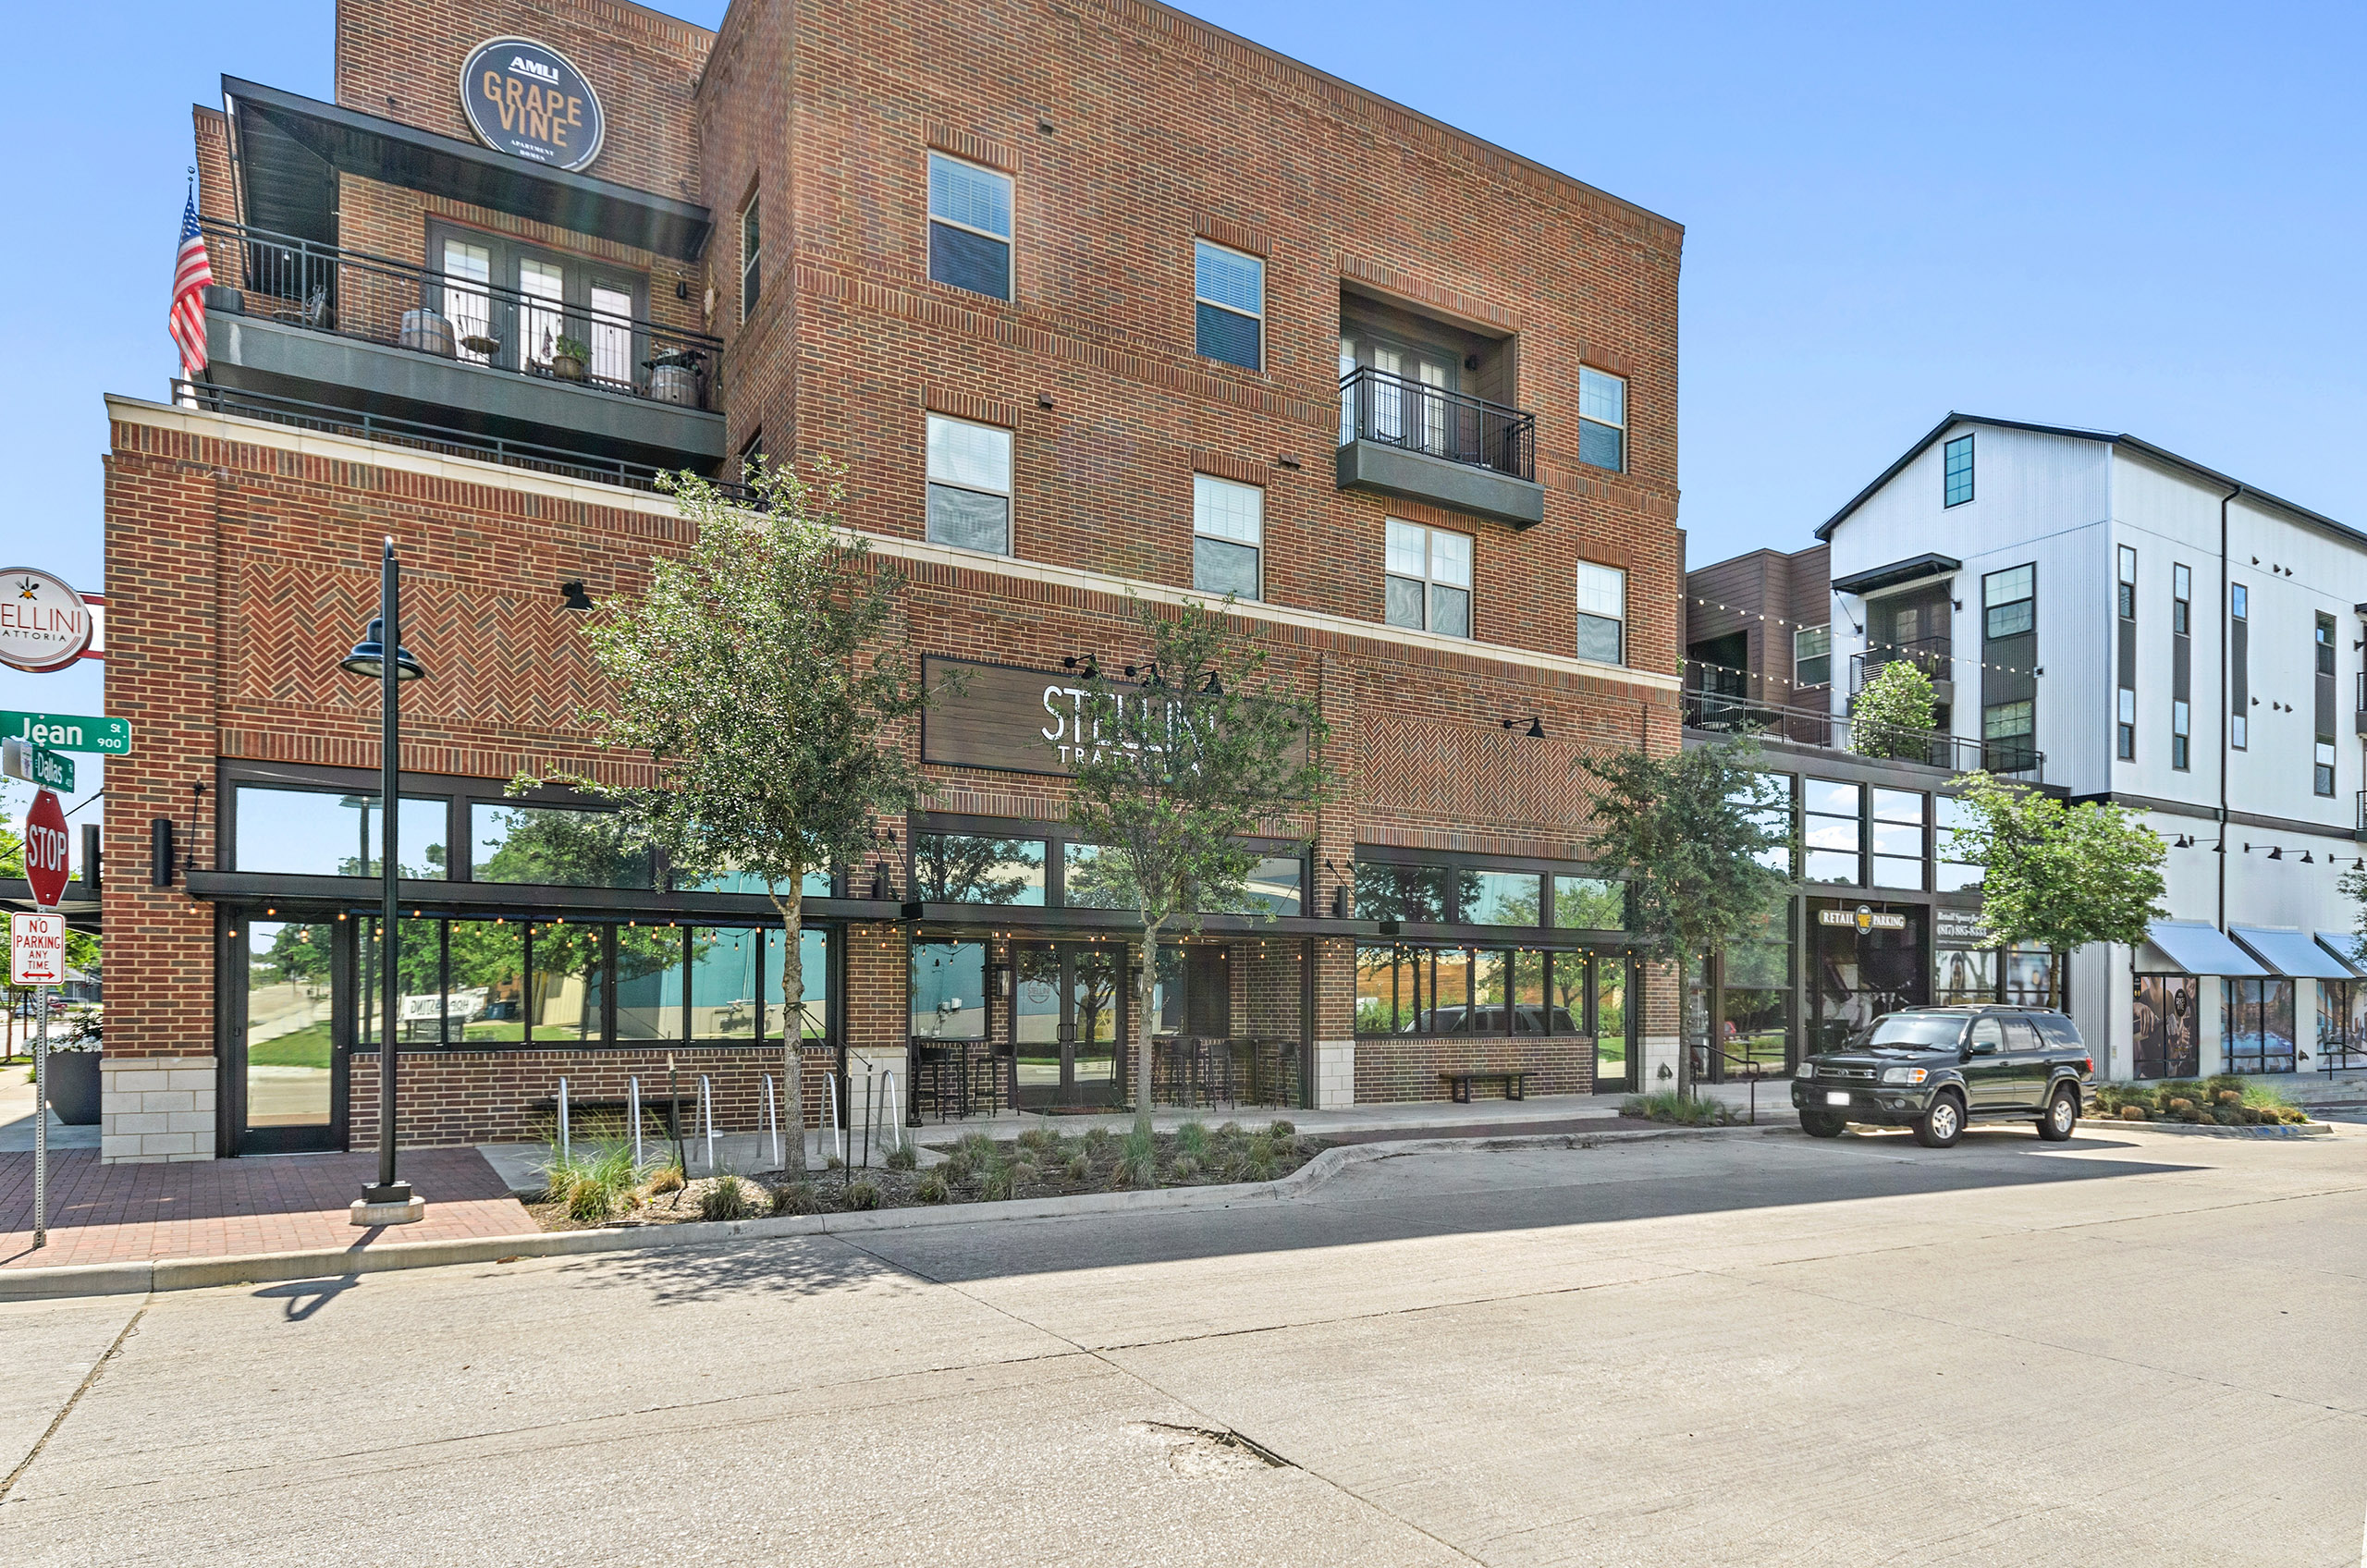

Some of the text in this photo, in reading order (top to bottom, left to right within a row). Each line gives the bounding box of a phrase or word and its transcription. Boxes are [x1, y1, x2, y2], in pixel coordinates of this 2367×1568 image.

[510, 55, 559, 81] AMLI
[483, 70, 583, 127] GRAPE
[497, 99, 568, 147] VINE
[510, 140, 555, 157] APARTMENT
[0, 603, 80, 634] ELLINI
[21, 717, 121, 746] Jean St
[97, 739, 122, 749] 900
[38, 752, 63, 784] Dallas
[28, 824, 67, 872] STOP
[30, 920, 48, 933] NO
[1823, 912, 1855, 925] RETAIL
[1872, 914, 1904, 927] PARKING
[17, 935, 61, 949] PARKING
[29, 950, 48, 959] ANY
[28, 961, 50, 970] TIME
